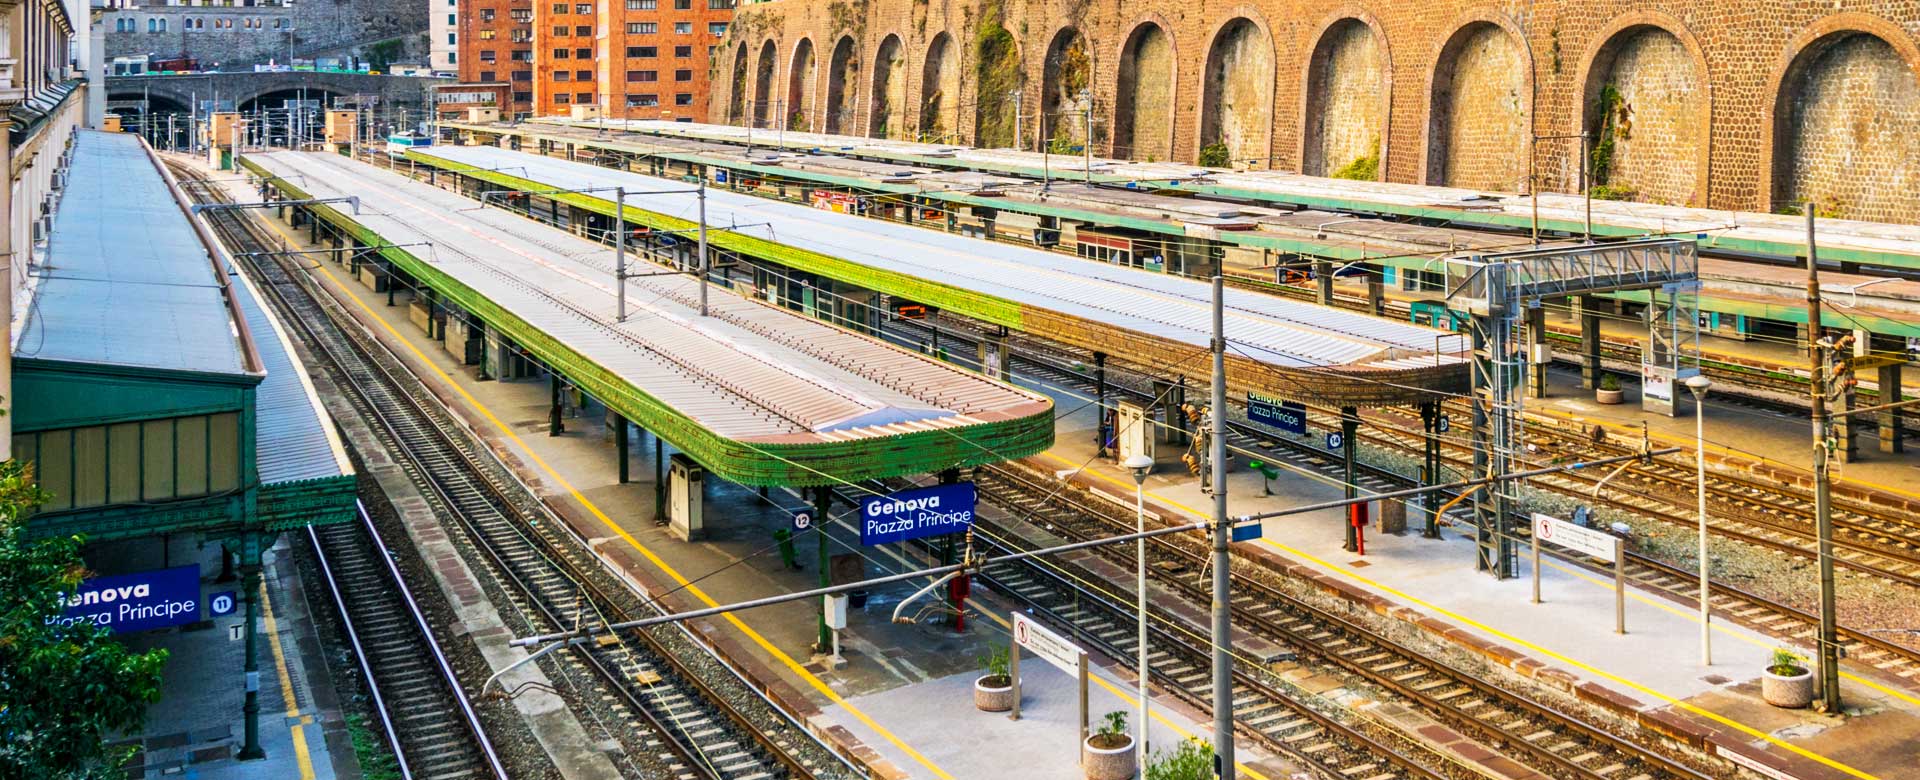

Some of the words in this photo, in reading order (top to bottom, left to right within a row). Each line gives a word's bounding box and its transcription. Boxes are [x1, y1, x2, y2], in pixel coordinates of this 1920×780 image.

[1249, 401, 1271, 418] Piazza
[1272, 407, 1299, 426] Principe
[867, 496, 940, 517] Genova
[867, 519, 914, 536] Piazza
[918, 509, 971, 527] Principe
[119, 599, 195, 622] Principe
